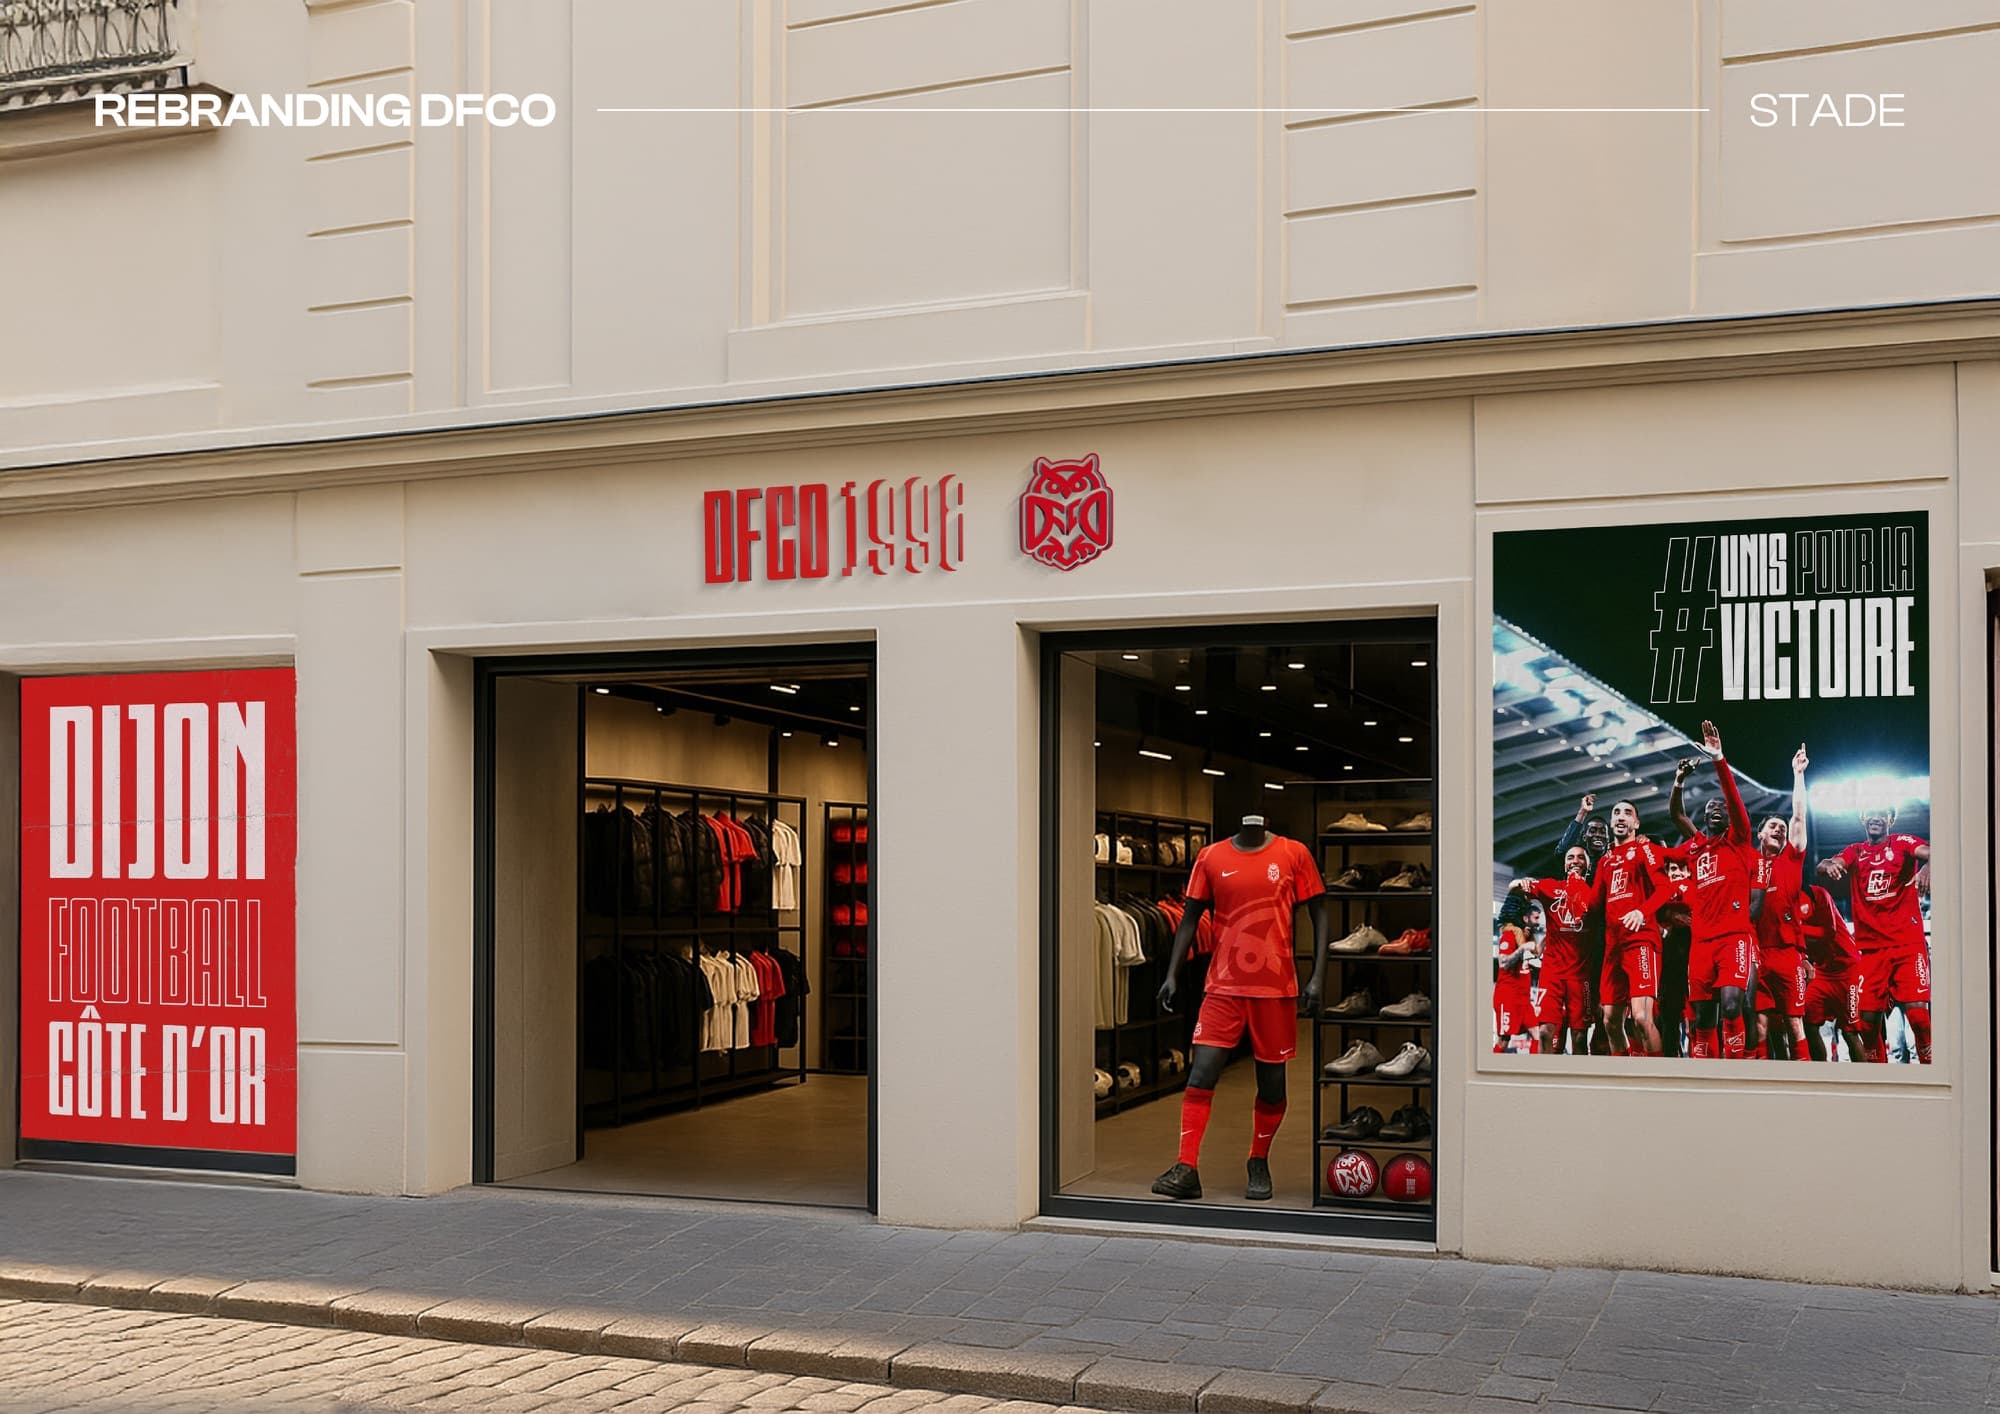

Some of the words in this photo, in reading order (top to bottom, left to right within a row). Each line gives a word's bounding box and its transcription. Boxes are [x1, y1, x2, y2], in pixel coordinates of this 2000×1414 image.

[704, 483, 831, 584] DFCO
[1720, 532, 1788, 598] UNIS
[1794, 527, 1874, 596] POUR
[1881, 525, 1915, 593] LA
[1720, 596, 1915, 701] VICTOIRE
[49, 701, 266, 880] DIJON
[48, 897, 267, 1009] FOOTBALL
[48, 1005, 147, 1121] CÔTE
